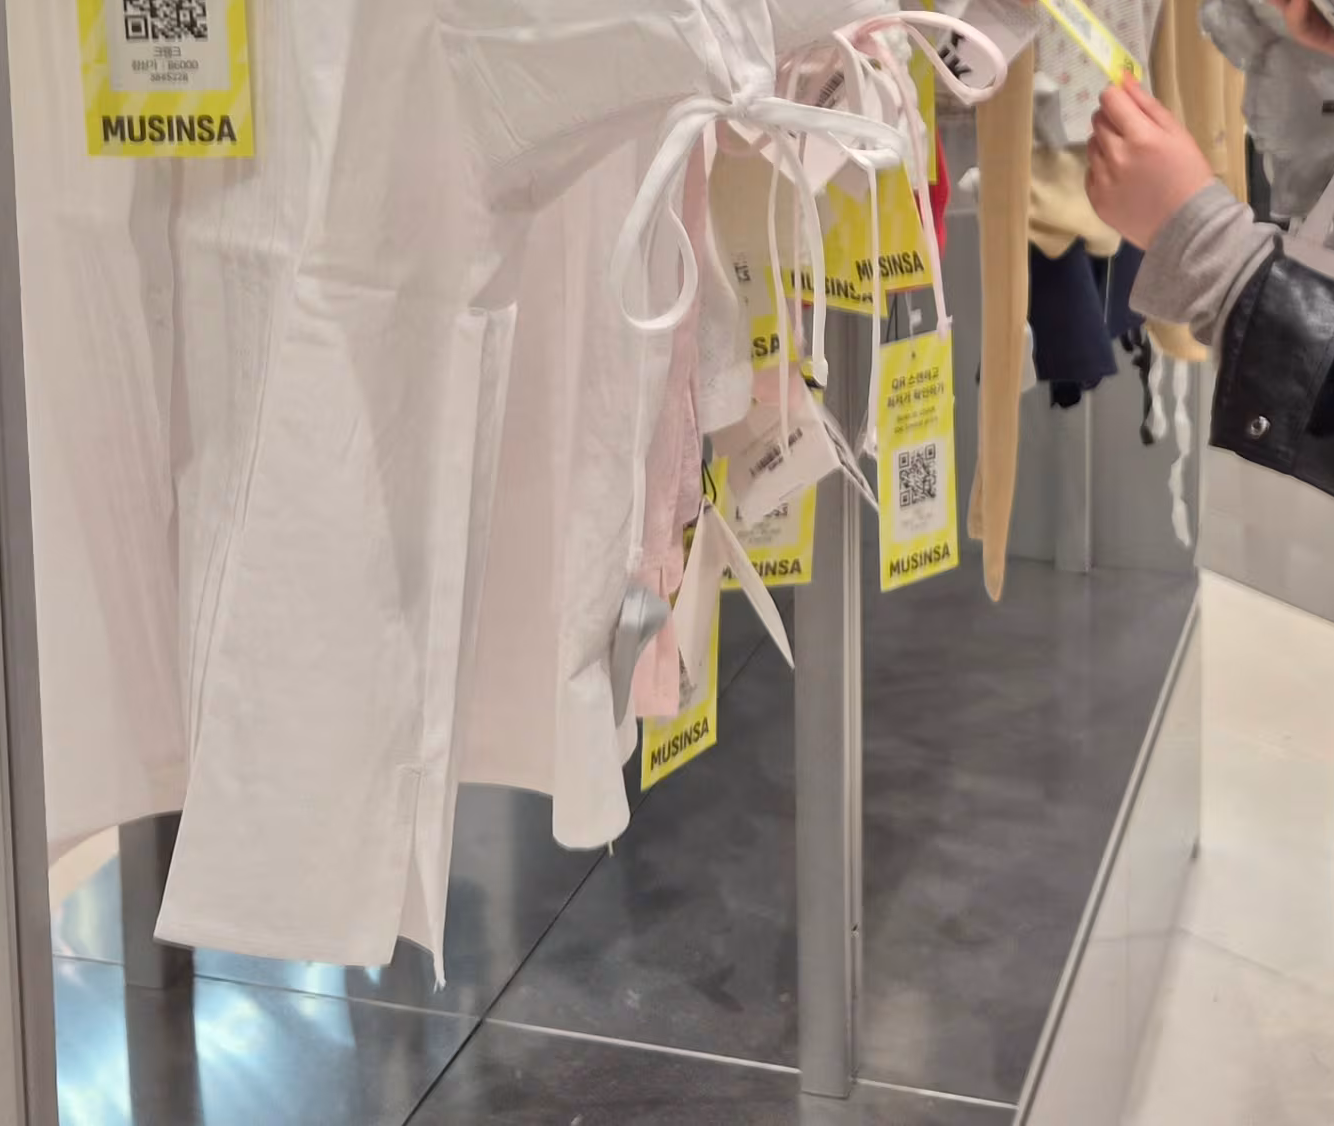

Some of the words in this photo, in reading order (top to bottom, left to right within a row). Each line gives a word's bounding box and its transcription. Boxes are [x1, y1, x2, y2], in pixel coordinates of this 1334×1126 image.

[101, 114, 238, 143] MUSINSA
[889, 541, 951, 579] MUSINSA
[650, 716, 710, 771] MUSINSA
